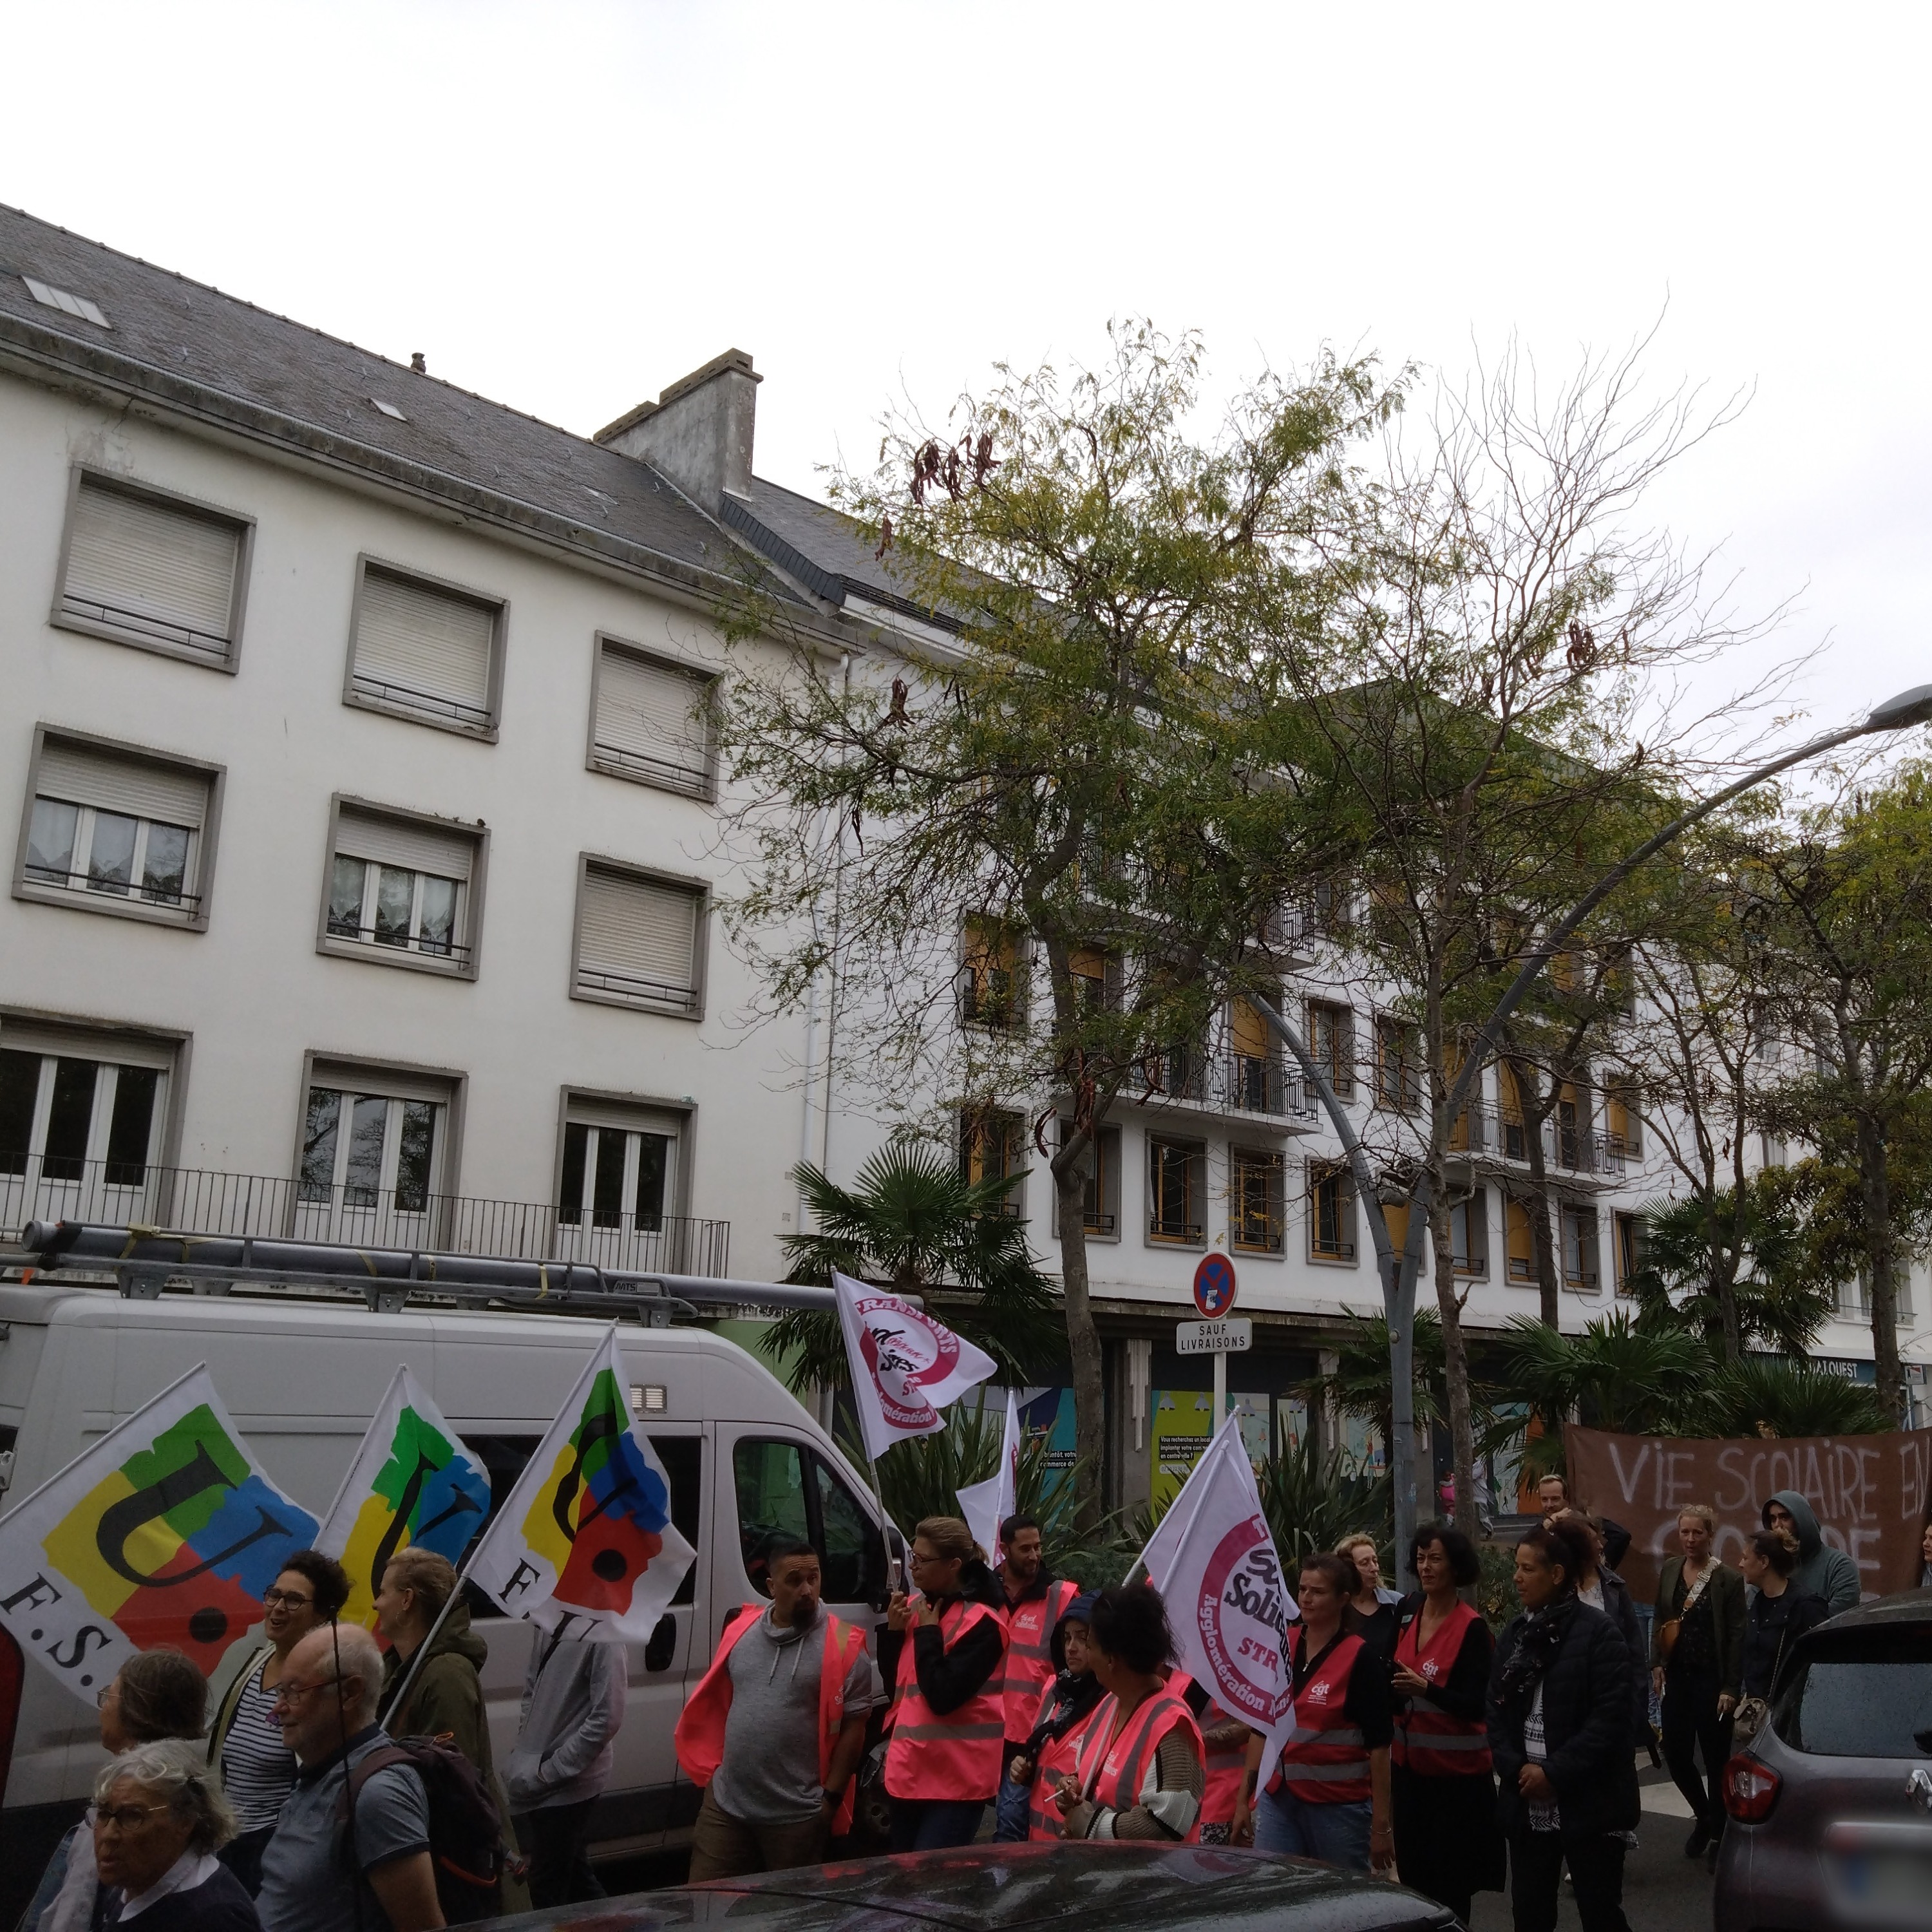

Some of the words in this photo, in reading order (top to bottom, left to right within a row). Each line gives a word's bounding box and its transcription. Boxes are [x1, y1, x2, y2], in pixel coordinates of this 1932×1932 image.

[1199, 1323, 1227, 1336] SAUF
[1181, 1336, 1245, 1350] LIVRAISONS
[1609, 1441, 1696, 1510] VIE
[1199, 1593, 1265, 1712] Agglomération
[1236, 1636, 1278, 1674] STR
[1311, 1683, 1331, 1696] cgt
